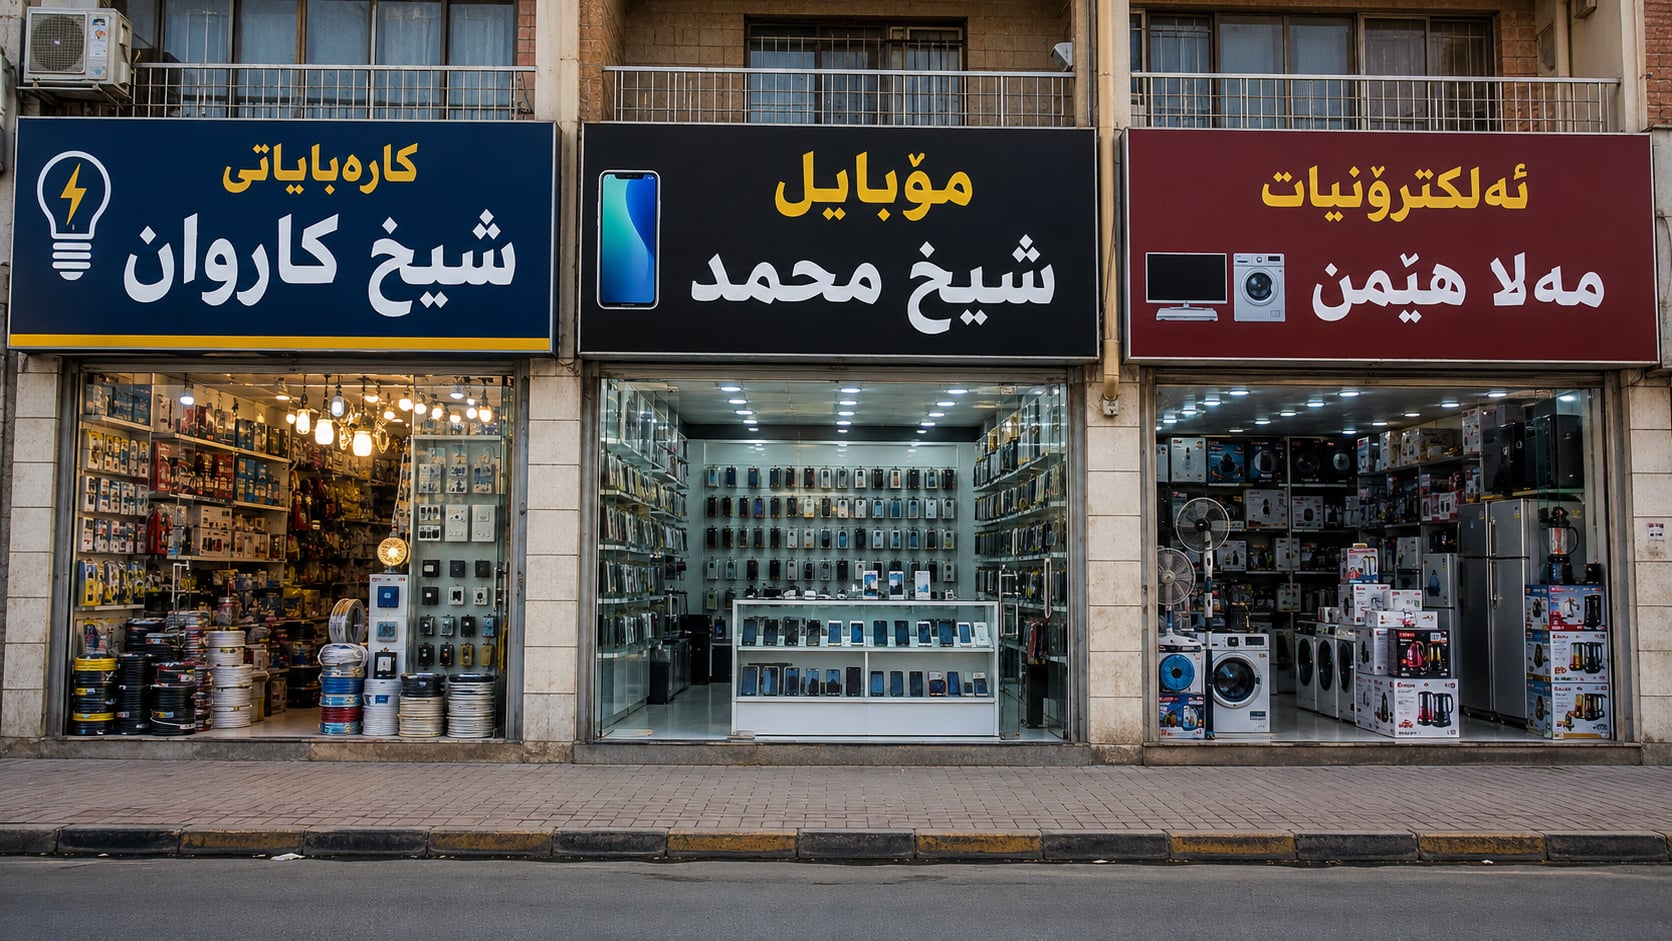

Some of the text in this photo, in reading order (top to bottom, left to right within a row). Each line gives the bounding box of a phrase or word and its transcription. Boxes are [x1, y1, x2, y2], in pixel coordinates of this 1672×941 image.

[774, 151, 973, 222] مۆبایل
[1261, 163, 1528, 223] ئەلکترۆنیات
[123, 208, 516, 318] شیخ کاروان
[691, 234, 1055, 335] شیخ محمد
[1312, 251, 1605, 324] مەلا هێمن
